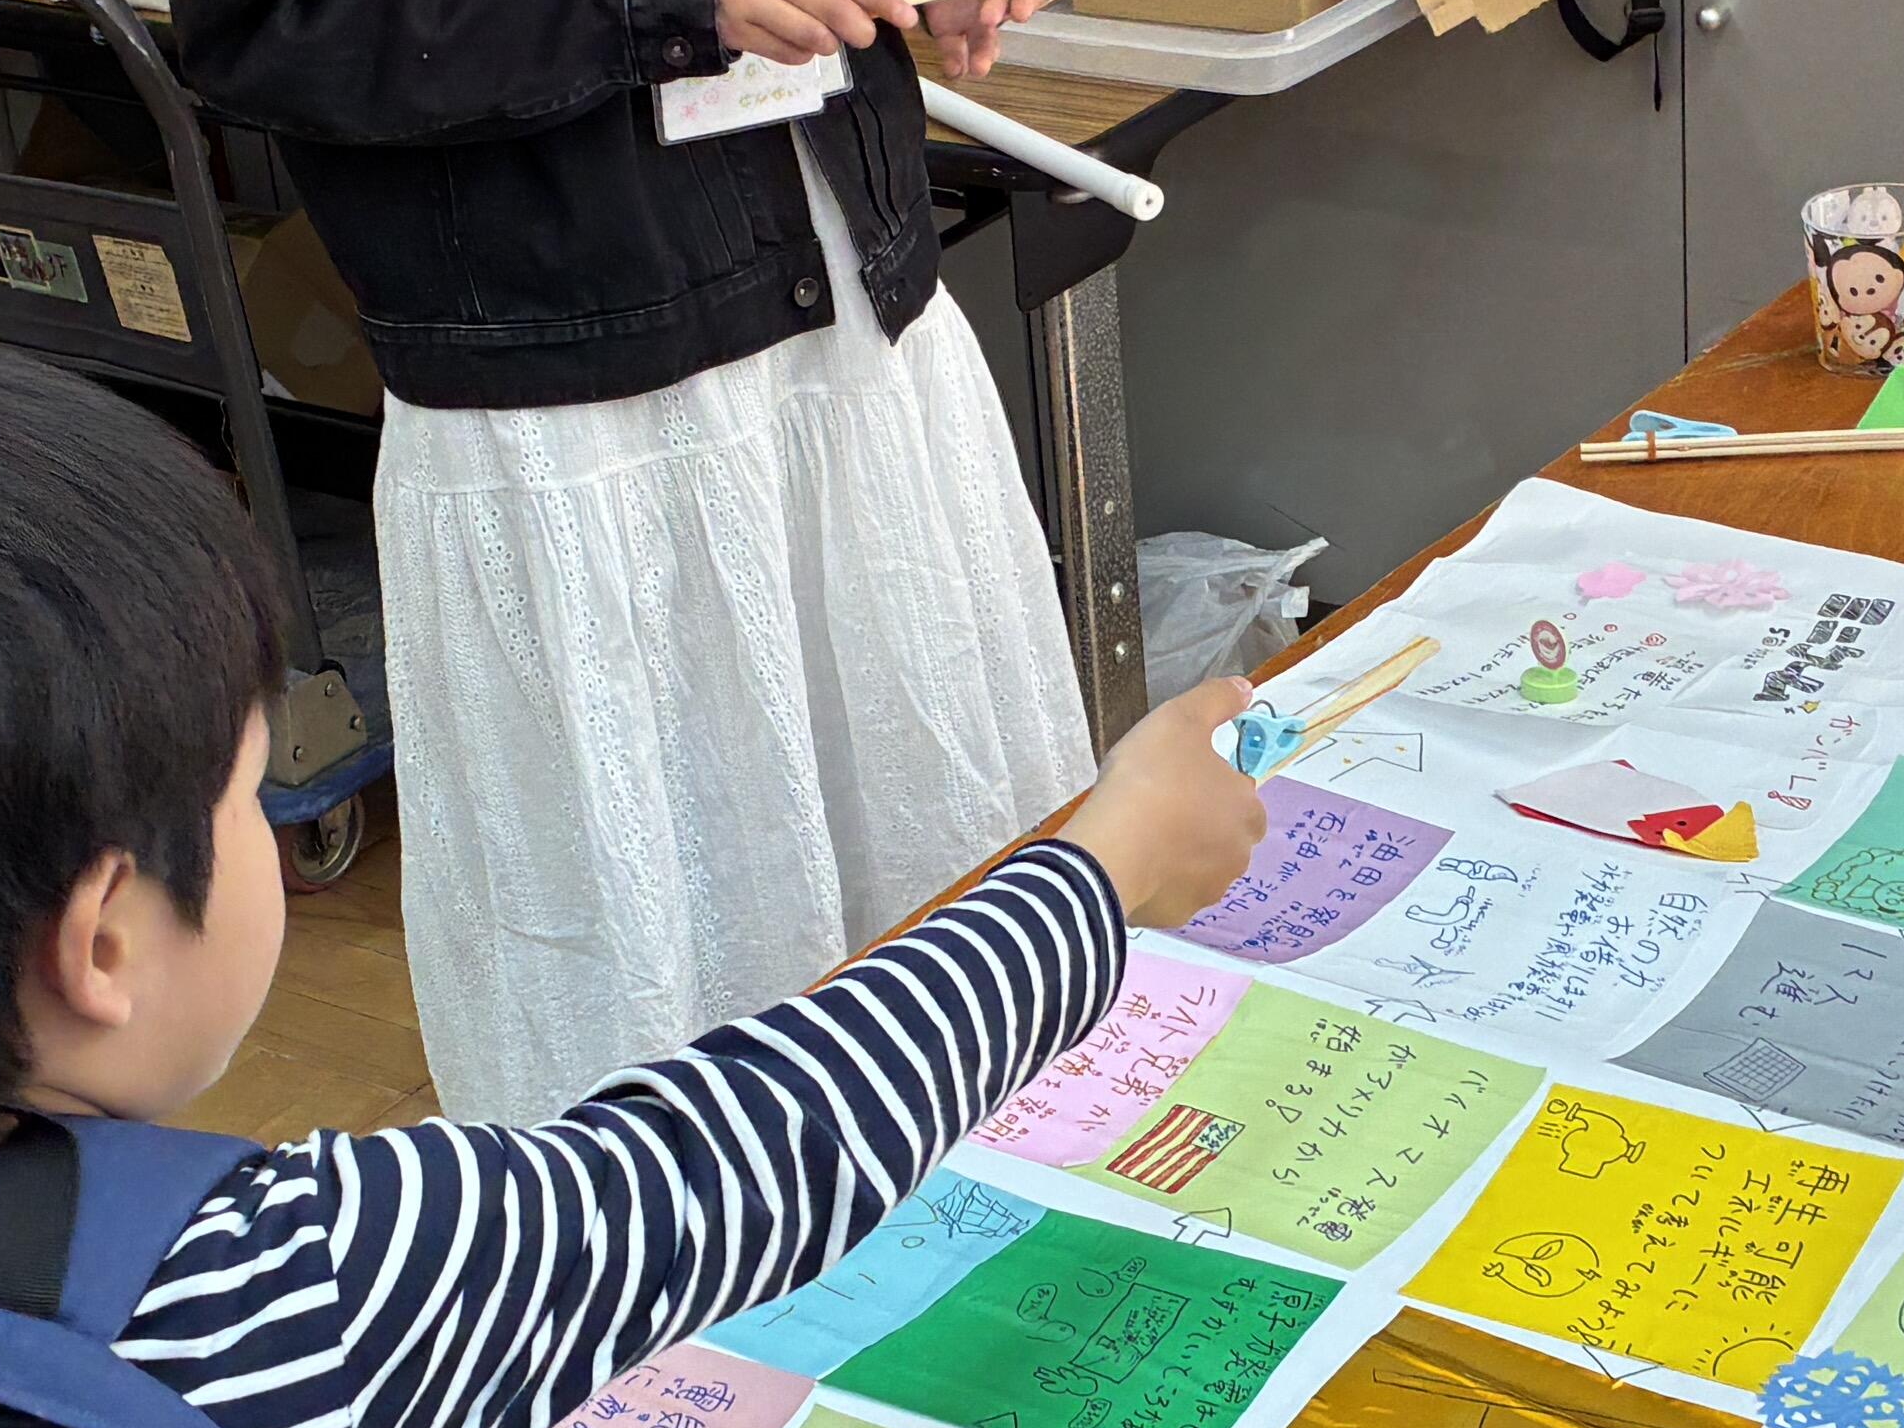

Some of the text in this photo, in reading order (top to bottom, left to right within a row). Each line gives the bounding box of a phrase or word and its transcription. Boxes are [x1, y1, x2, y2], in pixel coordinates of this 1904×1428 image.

[1733, 961, 1822, 1032] 進む
[1799, 942, 1890, 1013] 1マス
[1073, 983, 1226, 1134] ライト兄弟が
[1255, 1021, 1367, 1124] 始まる!
[1268, 1041, 1421, 1186] がアメリカから
[1309, 1069, 1492, 1244] バイオマス発電
[1559, 1139, 1741, 1348] ついて考えてみよう!
[1652, 1169, 1786, 1316] エネルギーに
[1717, 1161, 1861, 1311] 再生可能
